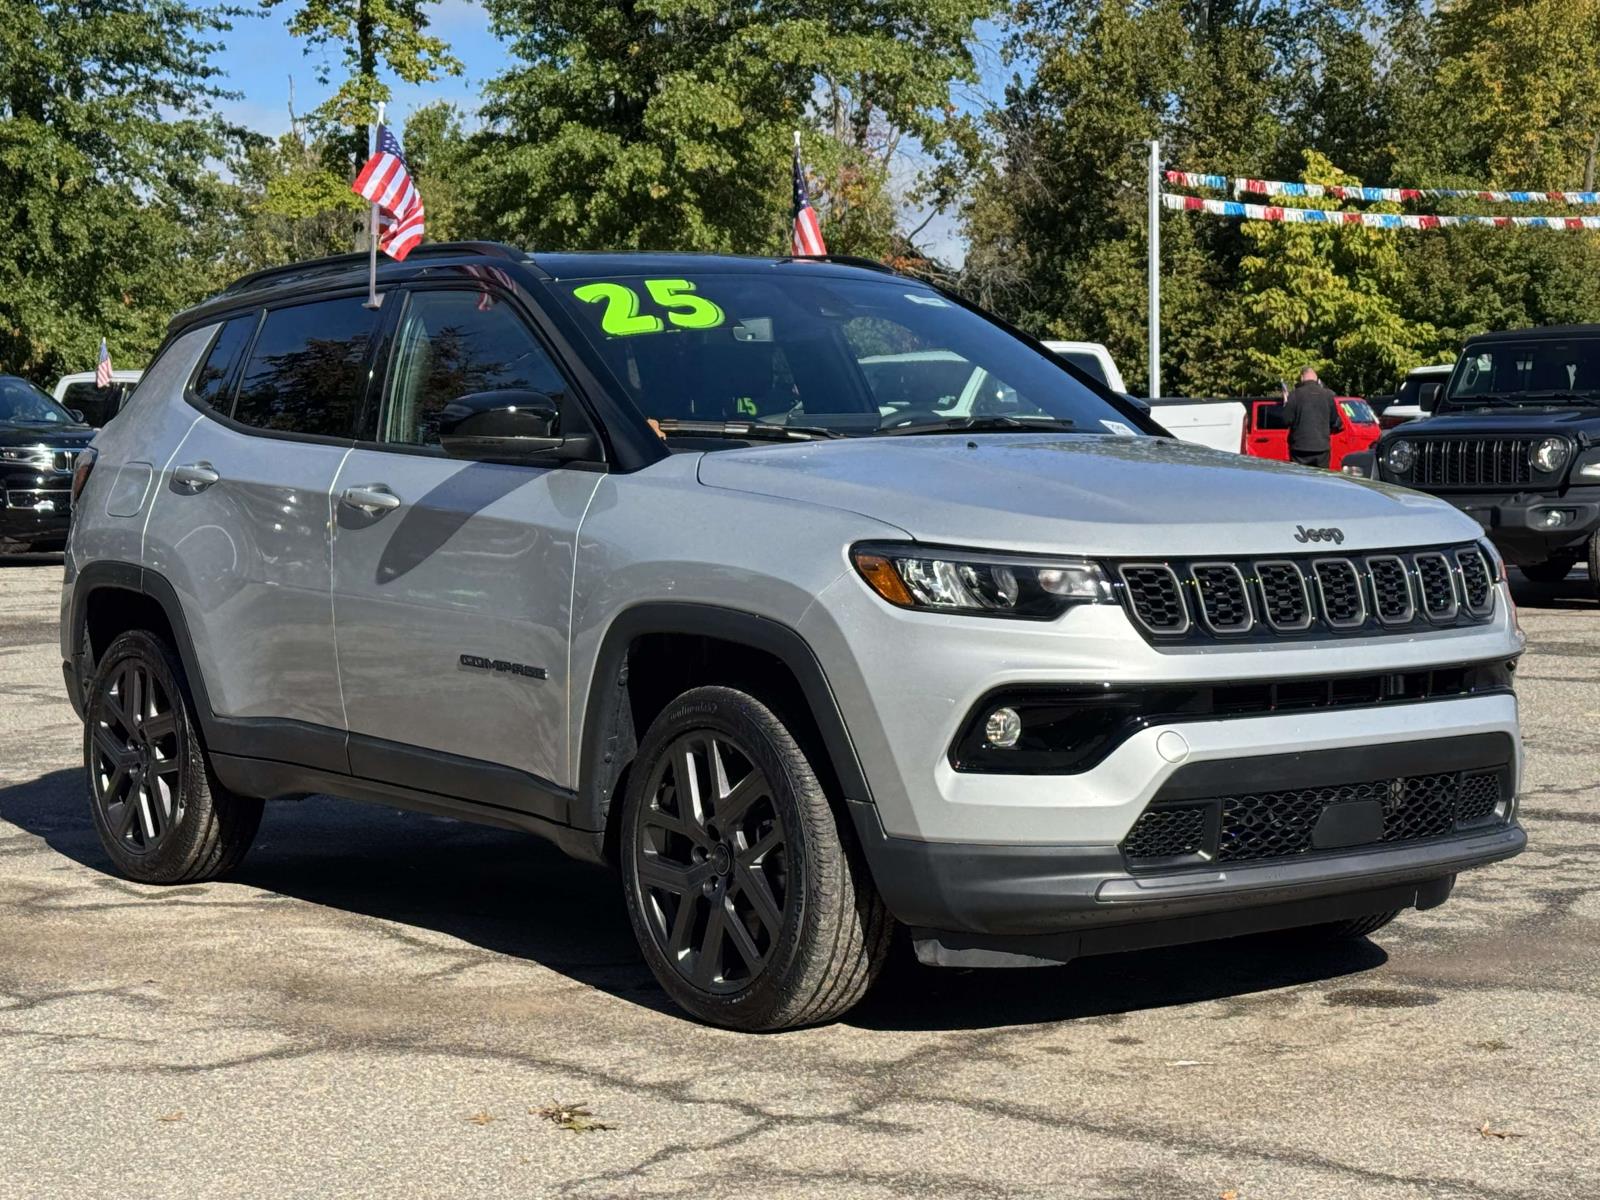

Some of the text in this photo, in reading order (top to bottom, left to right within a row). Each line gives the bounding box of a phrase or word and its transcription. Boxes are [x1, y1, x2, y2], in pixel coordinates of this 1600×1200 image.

[573, 279, 725, 336] 25
[1293, 524, 1345, 545] Jeep
[460, 654, 548, 680] COMPASS
